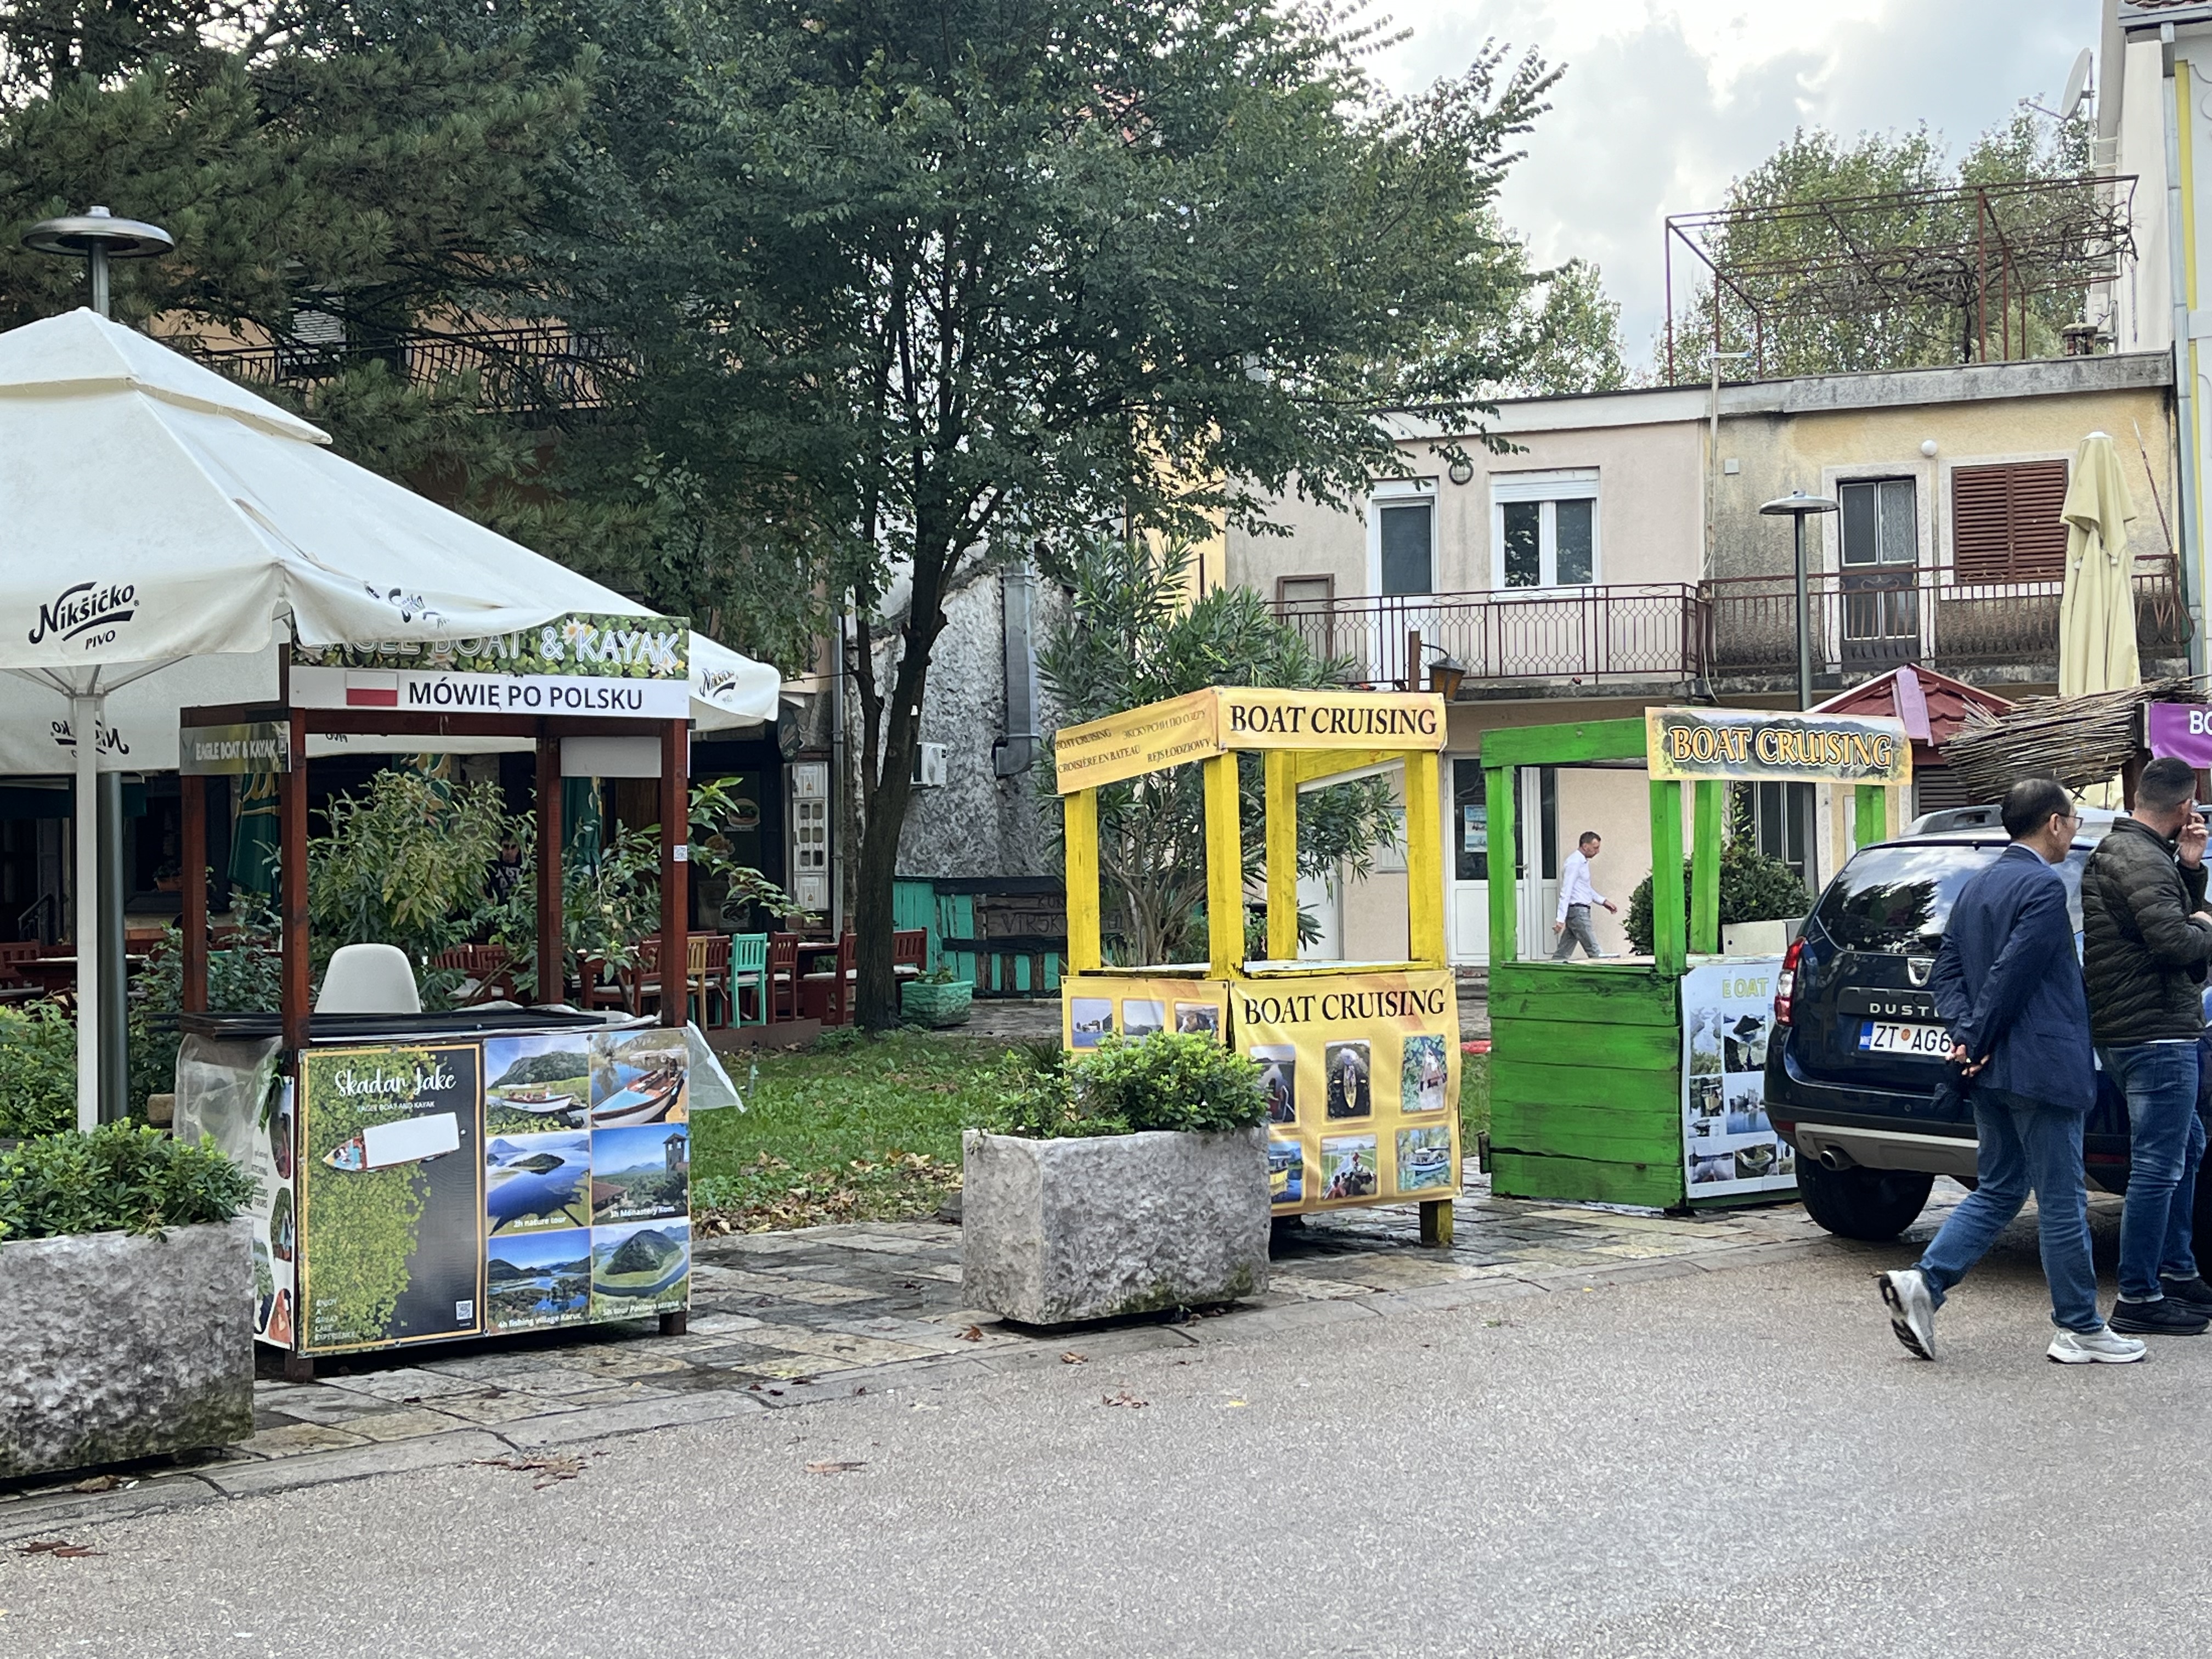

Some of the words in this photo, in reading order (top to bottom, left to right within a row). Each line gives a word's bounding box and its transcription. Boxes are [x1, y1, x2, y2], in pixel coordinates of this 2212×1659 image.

[29, 582, 135, 644] Nikšičko
[85, 630, 116, 650] PIVO
[540, 626, 565, 660] &
[576, 629, 679, 664] KAYAK
[409, 677, 500, 711] MÓWIĘ
[508, 686, 542, 707] PO
[550, 687, 643, 710] POLSKU
[1229, 704, 1306, 733] BOAT
[1311, 707, 1437, 735] CRUISING
[1075, 728, 1112, 746] CRUISING
[1670, 725, 1753, 764] BOAT
[1757, 728, 1893, 769] CRUISING
[196, 742, 219, 761] EAGLE
[220, 741, 240, 760] BOAT
[242, 741, 249, 758] &
[250, 739, 276, 758] KAYAK
[1098, 753, 1110, 764] EN
[1110, 744, 1141, 761] BATEAU
[1722, 977, 1769, 998] BOAT
[1243, 994, 1316, 1024] BOAT
[1321, 988, 1446, 1020] CRUISING
[1874, 1025, 1899, 1049] ZT
[335, 1068, 408, 1097] Skadar
[524, 1218, 549, 1227] nature
[620, 1207, 658, 1217] Monastery
